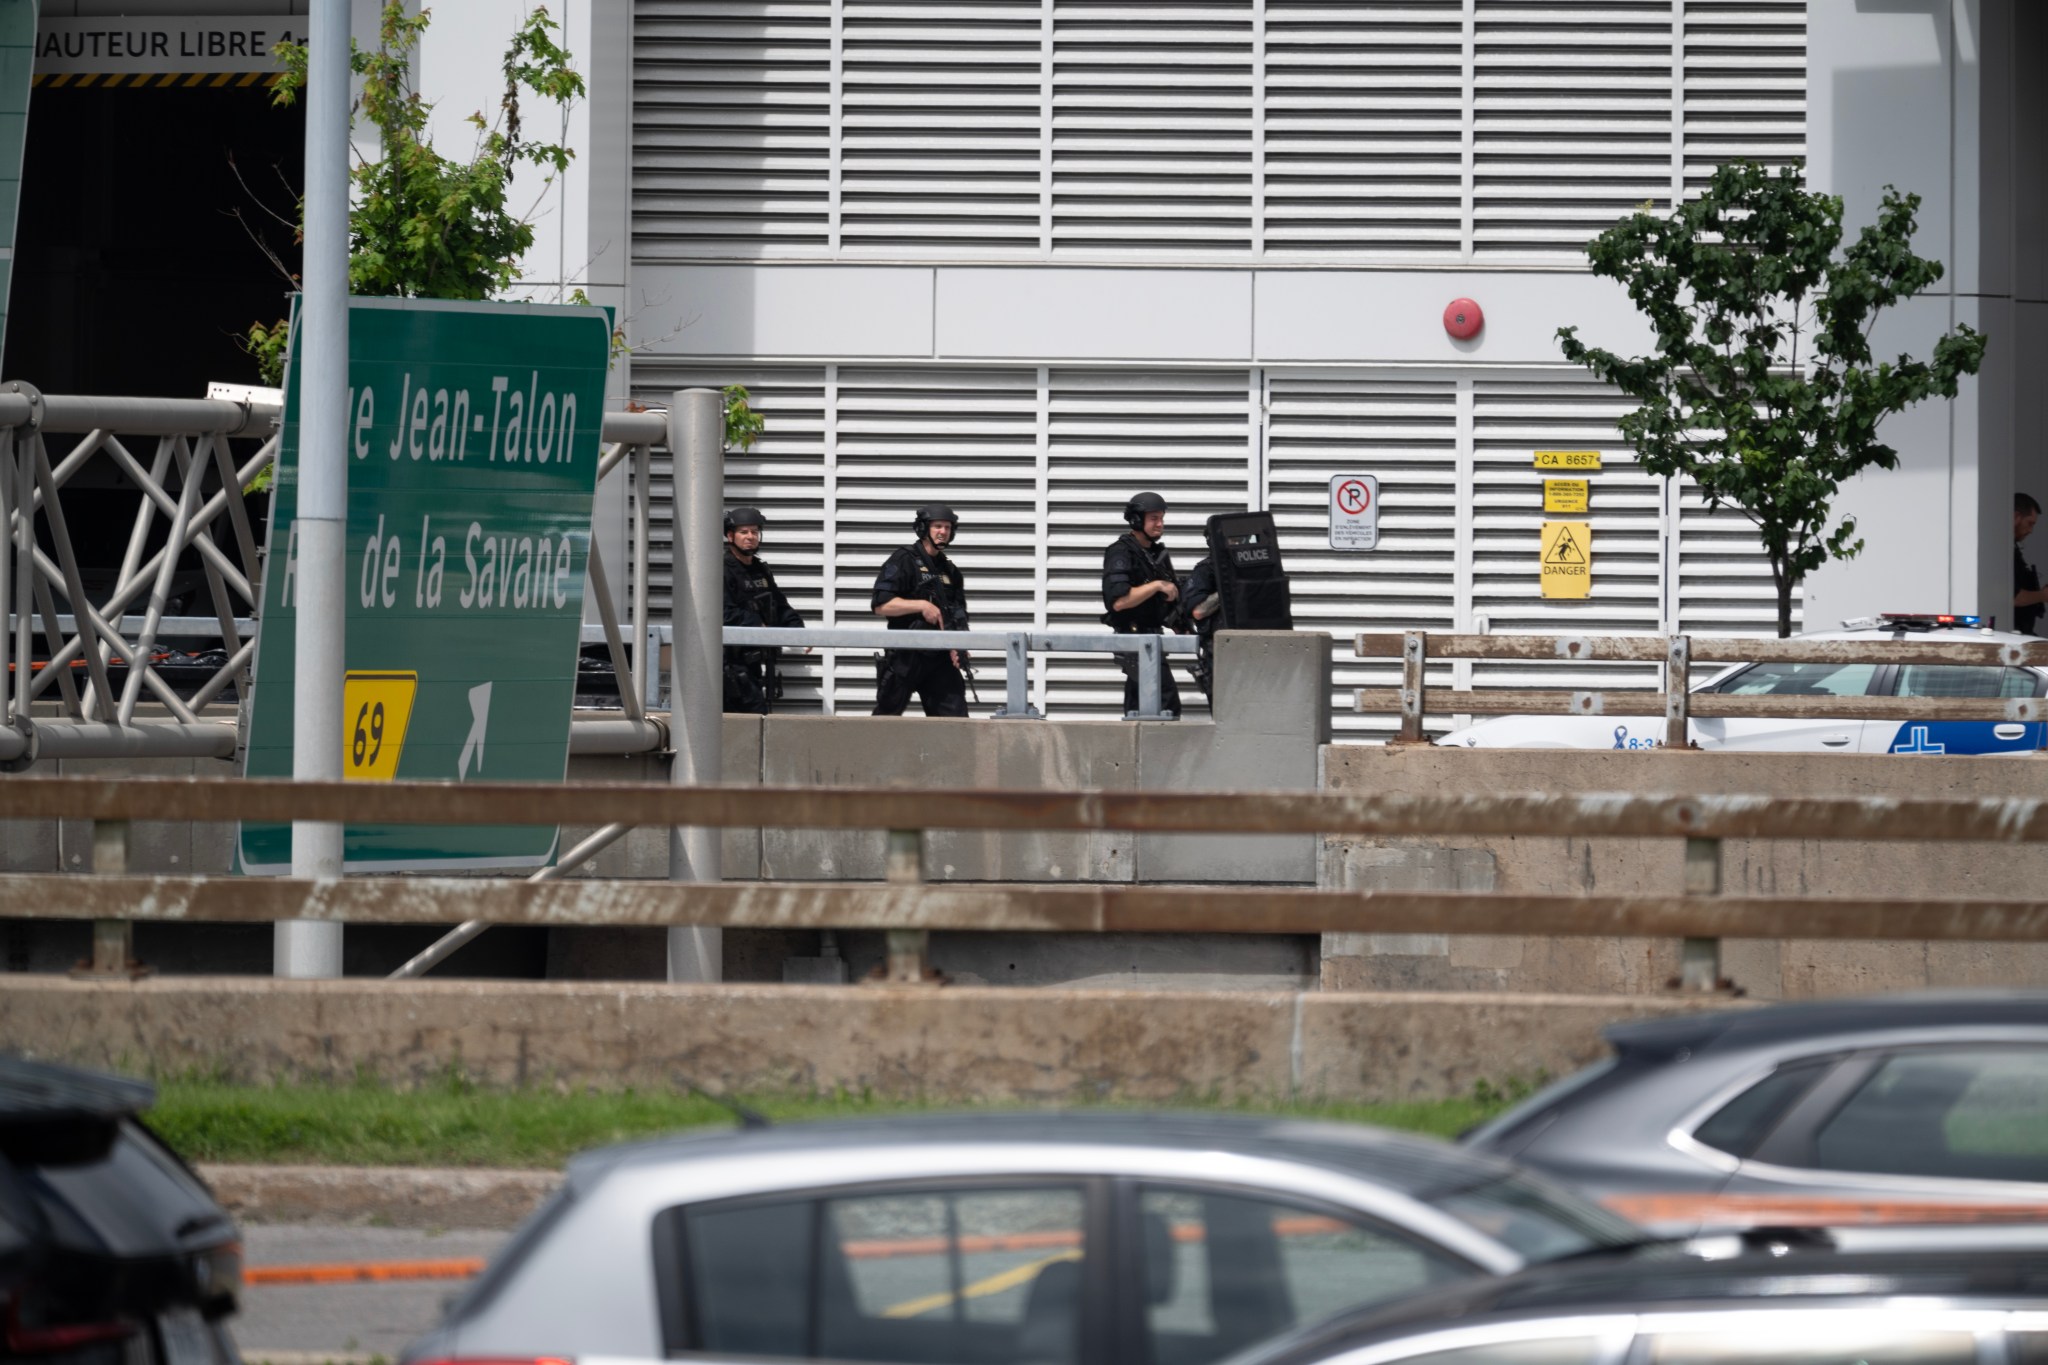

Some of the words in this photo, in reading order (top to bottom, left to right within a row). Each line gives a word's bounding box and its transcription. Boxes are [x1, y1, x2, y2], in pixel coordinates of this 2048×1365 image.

[180, 31, 266, 57] LIBRE
[390, 370, 577, 463] Jean-Talon
[1541, 454, 1559, 465] CA
[1566, 455, 1595, 466] 8657
[361, 513, 400, 609] de
[416, 514, 446, 609] la
[460, 521, 572, 609] Savane
[1237, 549, 1269, 562] POLICE
[1544, 566, 1586, 576] DANGER
[353, 701, 384, 767] 69
